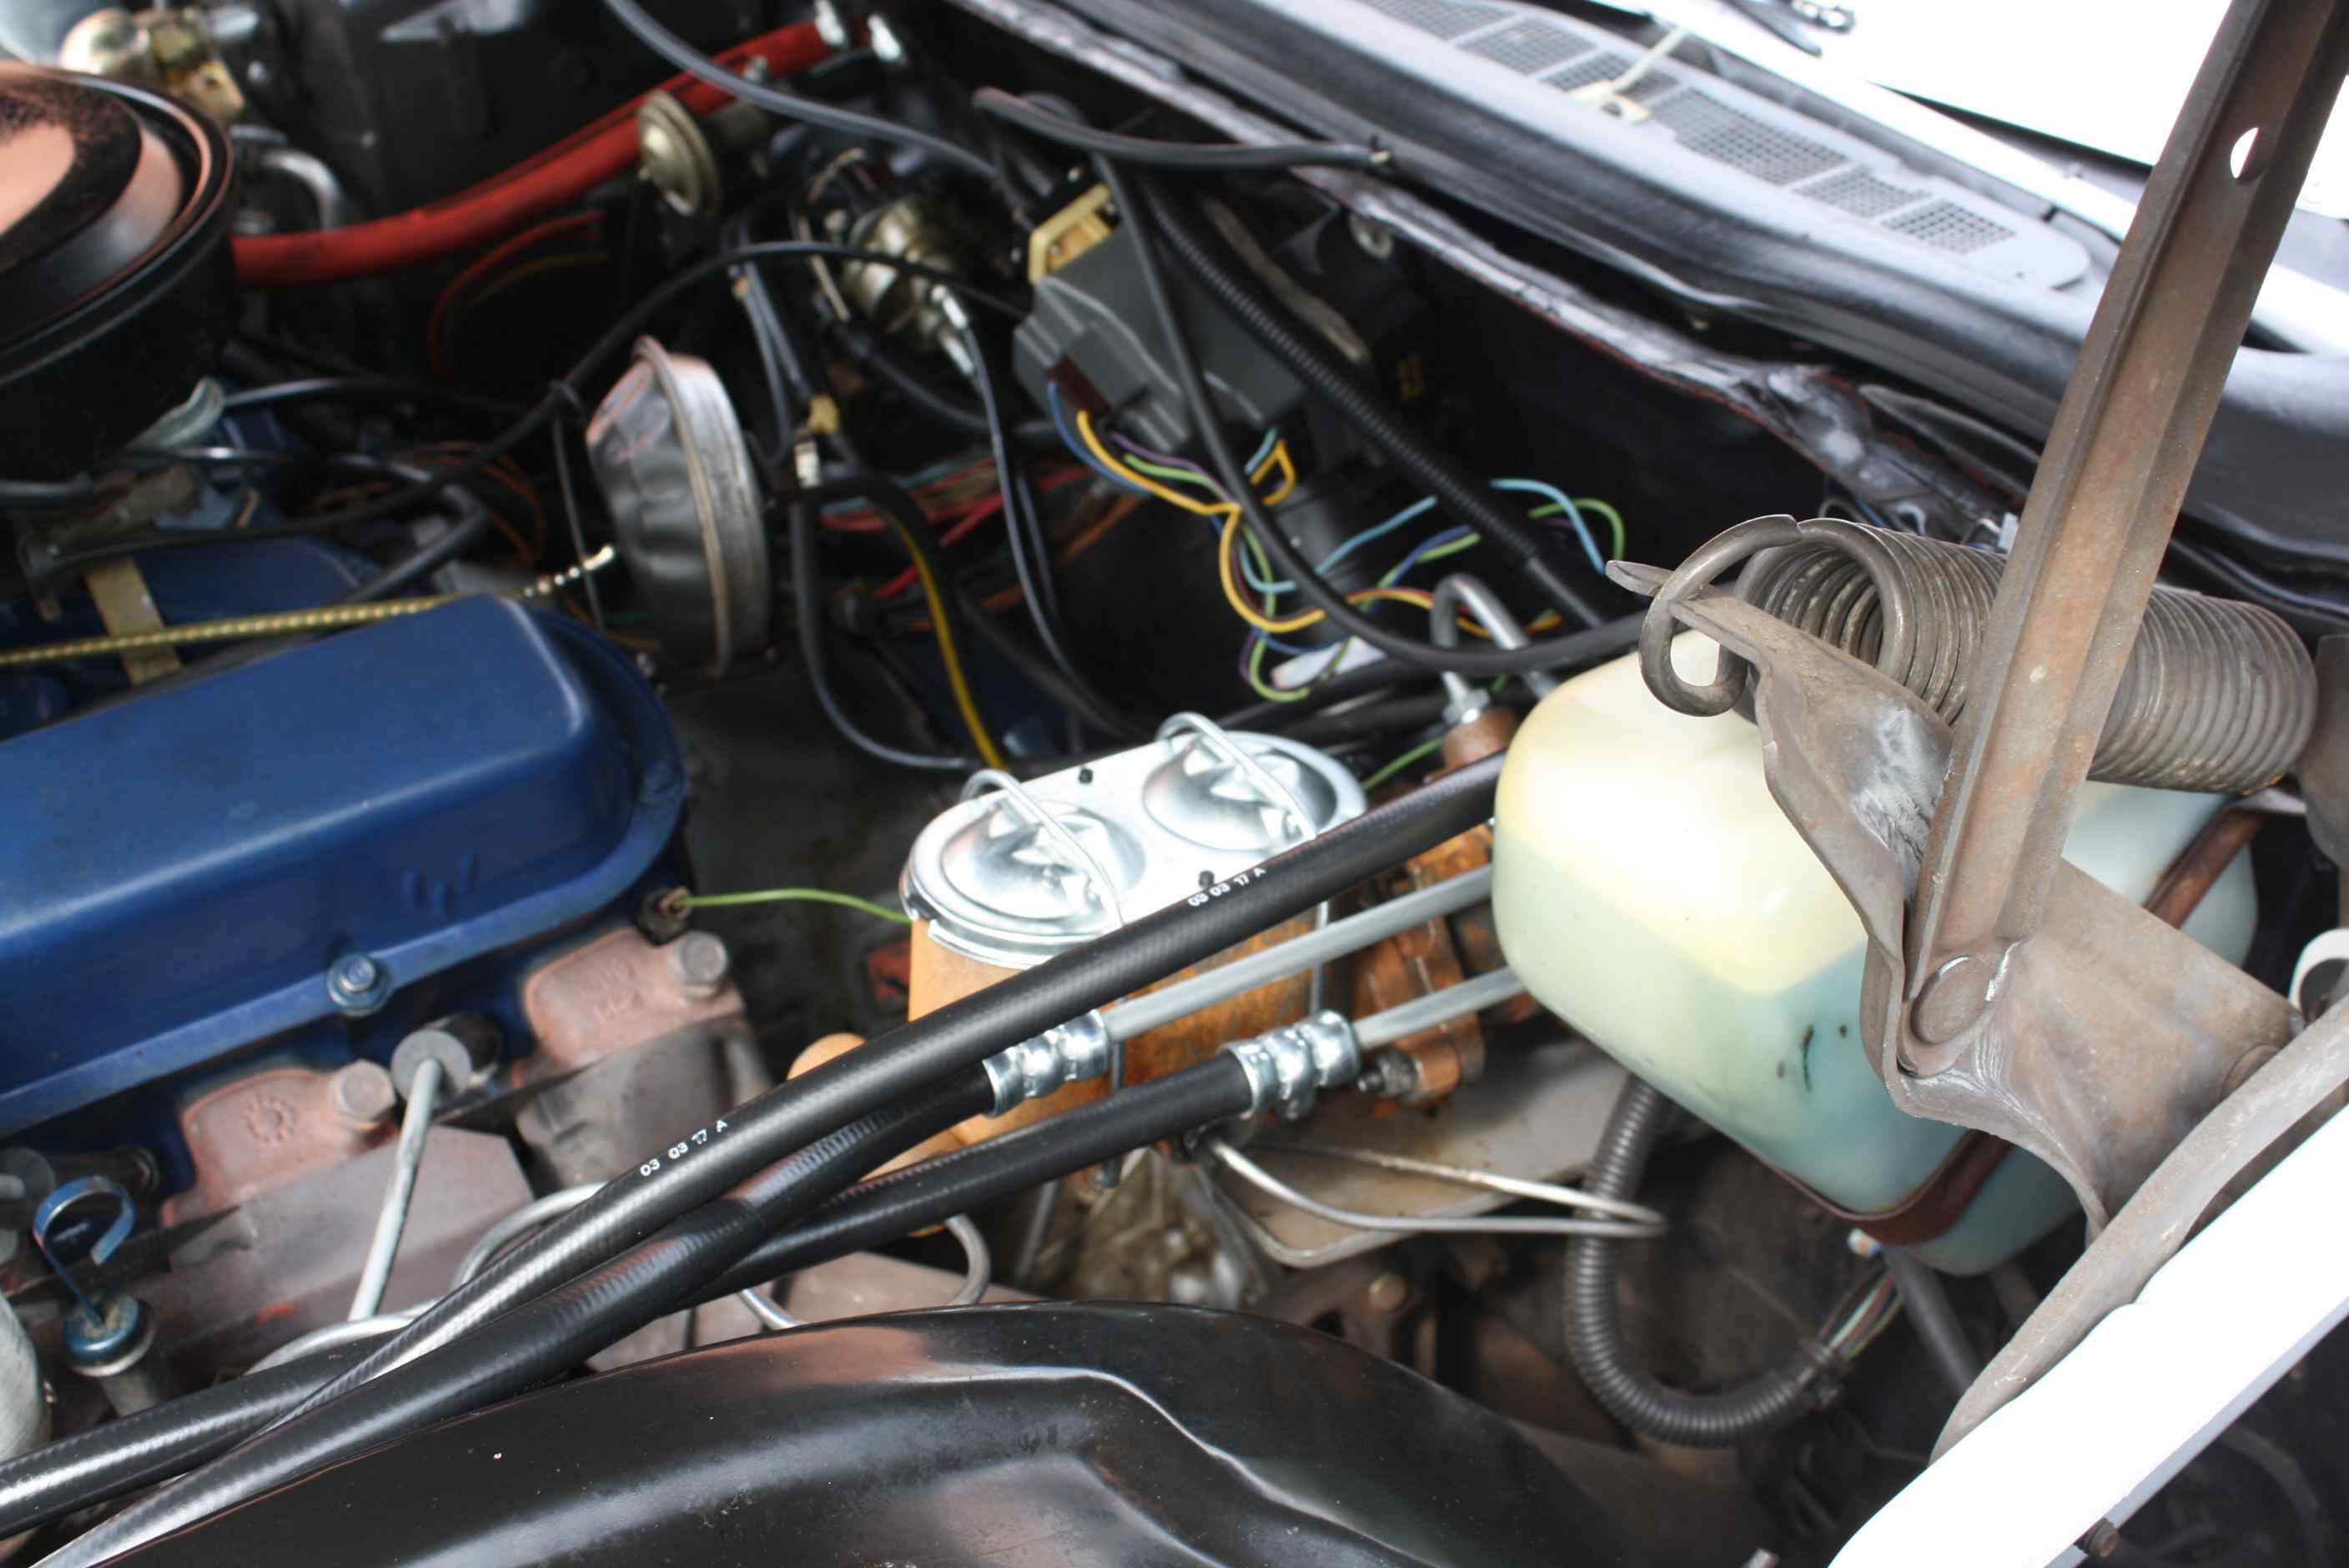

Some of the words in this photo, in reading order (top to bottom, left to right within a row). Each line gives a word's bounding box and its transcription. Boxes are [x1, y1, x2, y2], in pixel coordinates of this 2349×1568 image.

[1187, 892, 1209, 907] 03
[1210, 883, 1230, 897] 03
[641, 1158, 661, 1176] 03
[668, 1142, 689, 1159] 03
